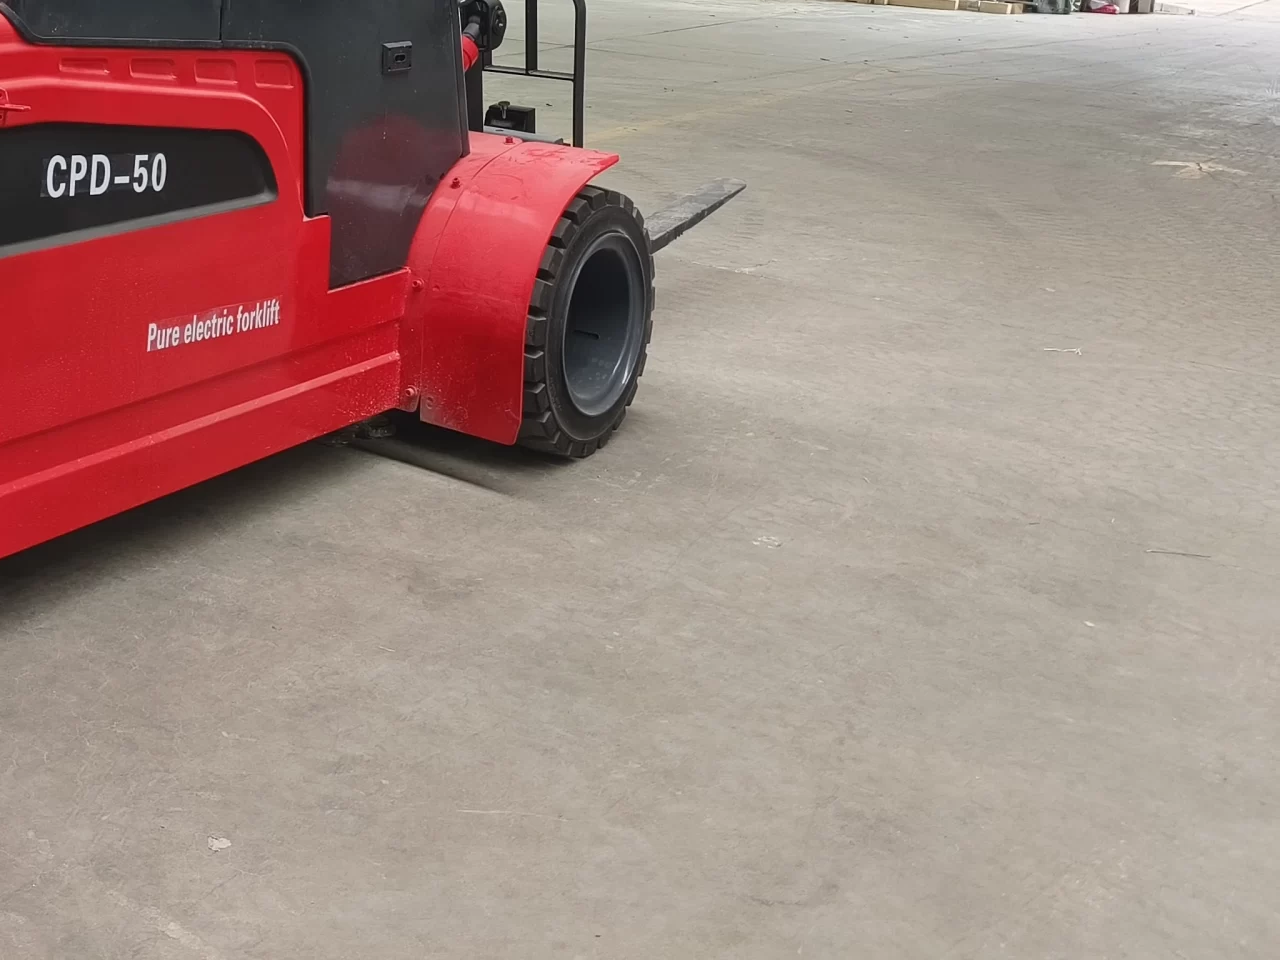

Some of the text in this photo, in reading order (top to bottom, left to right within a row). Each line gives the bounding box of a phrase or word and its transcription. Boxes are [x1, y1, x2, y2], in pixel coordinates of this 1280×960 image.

[46, 152, 167, 198] CPD-50
[146, 298, 280, 352] Pure electric forklift
